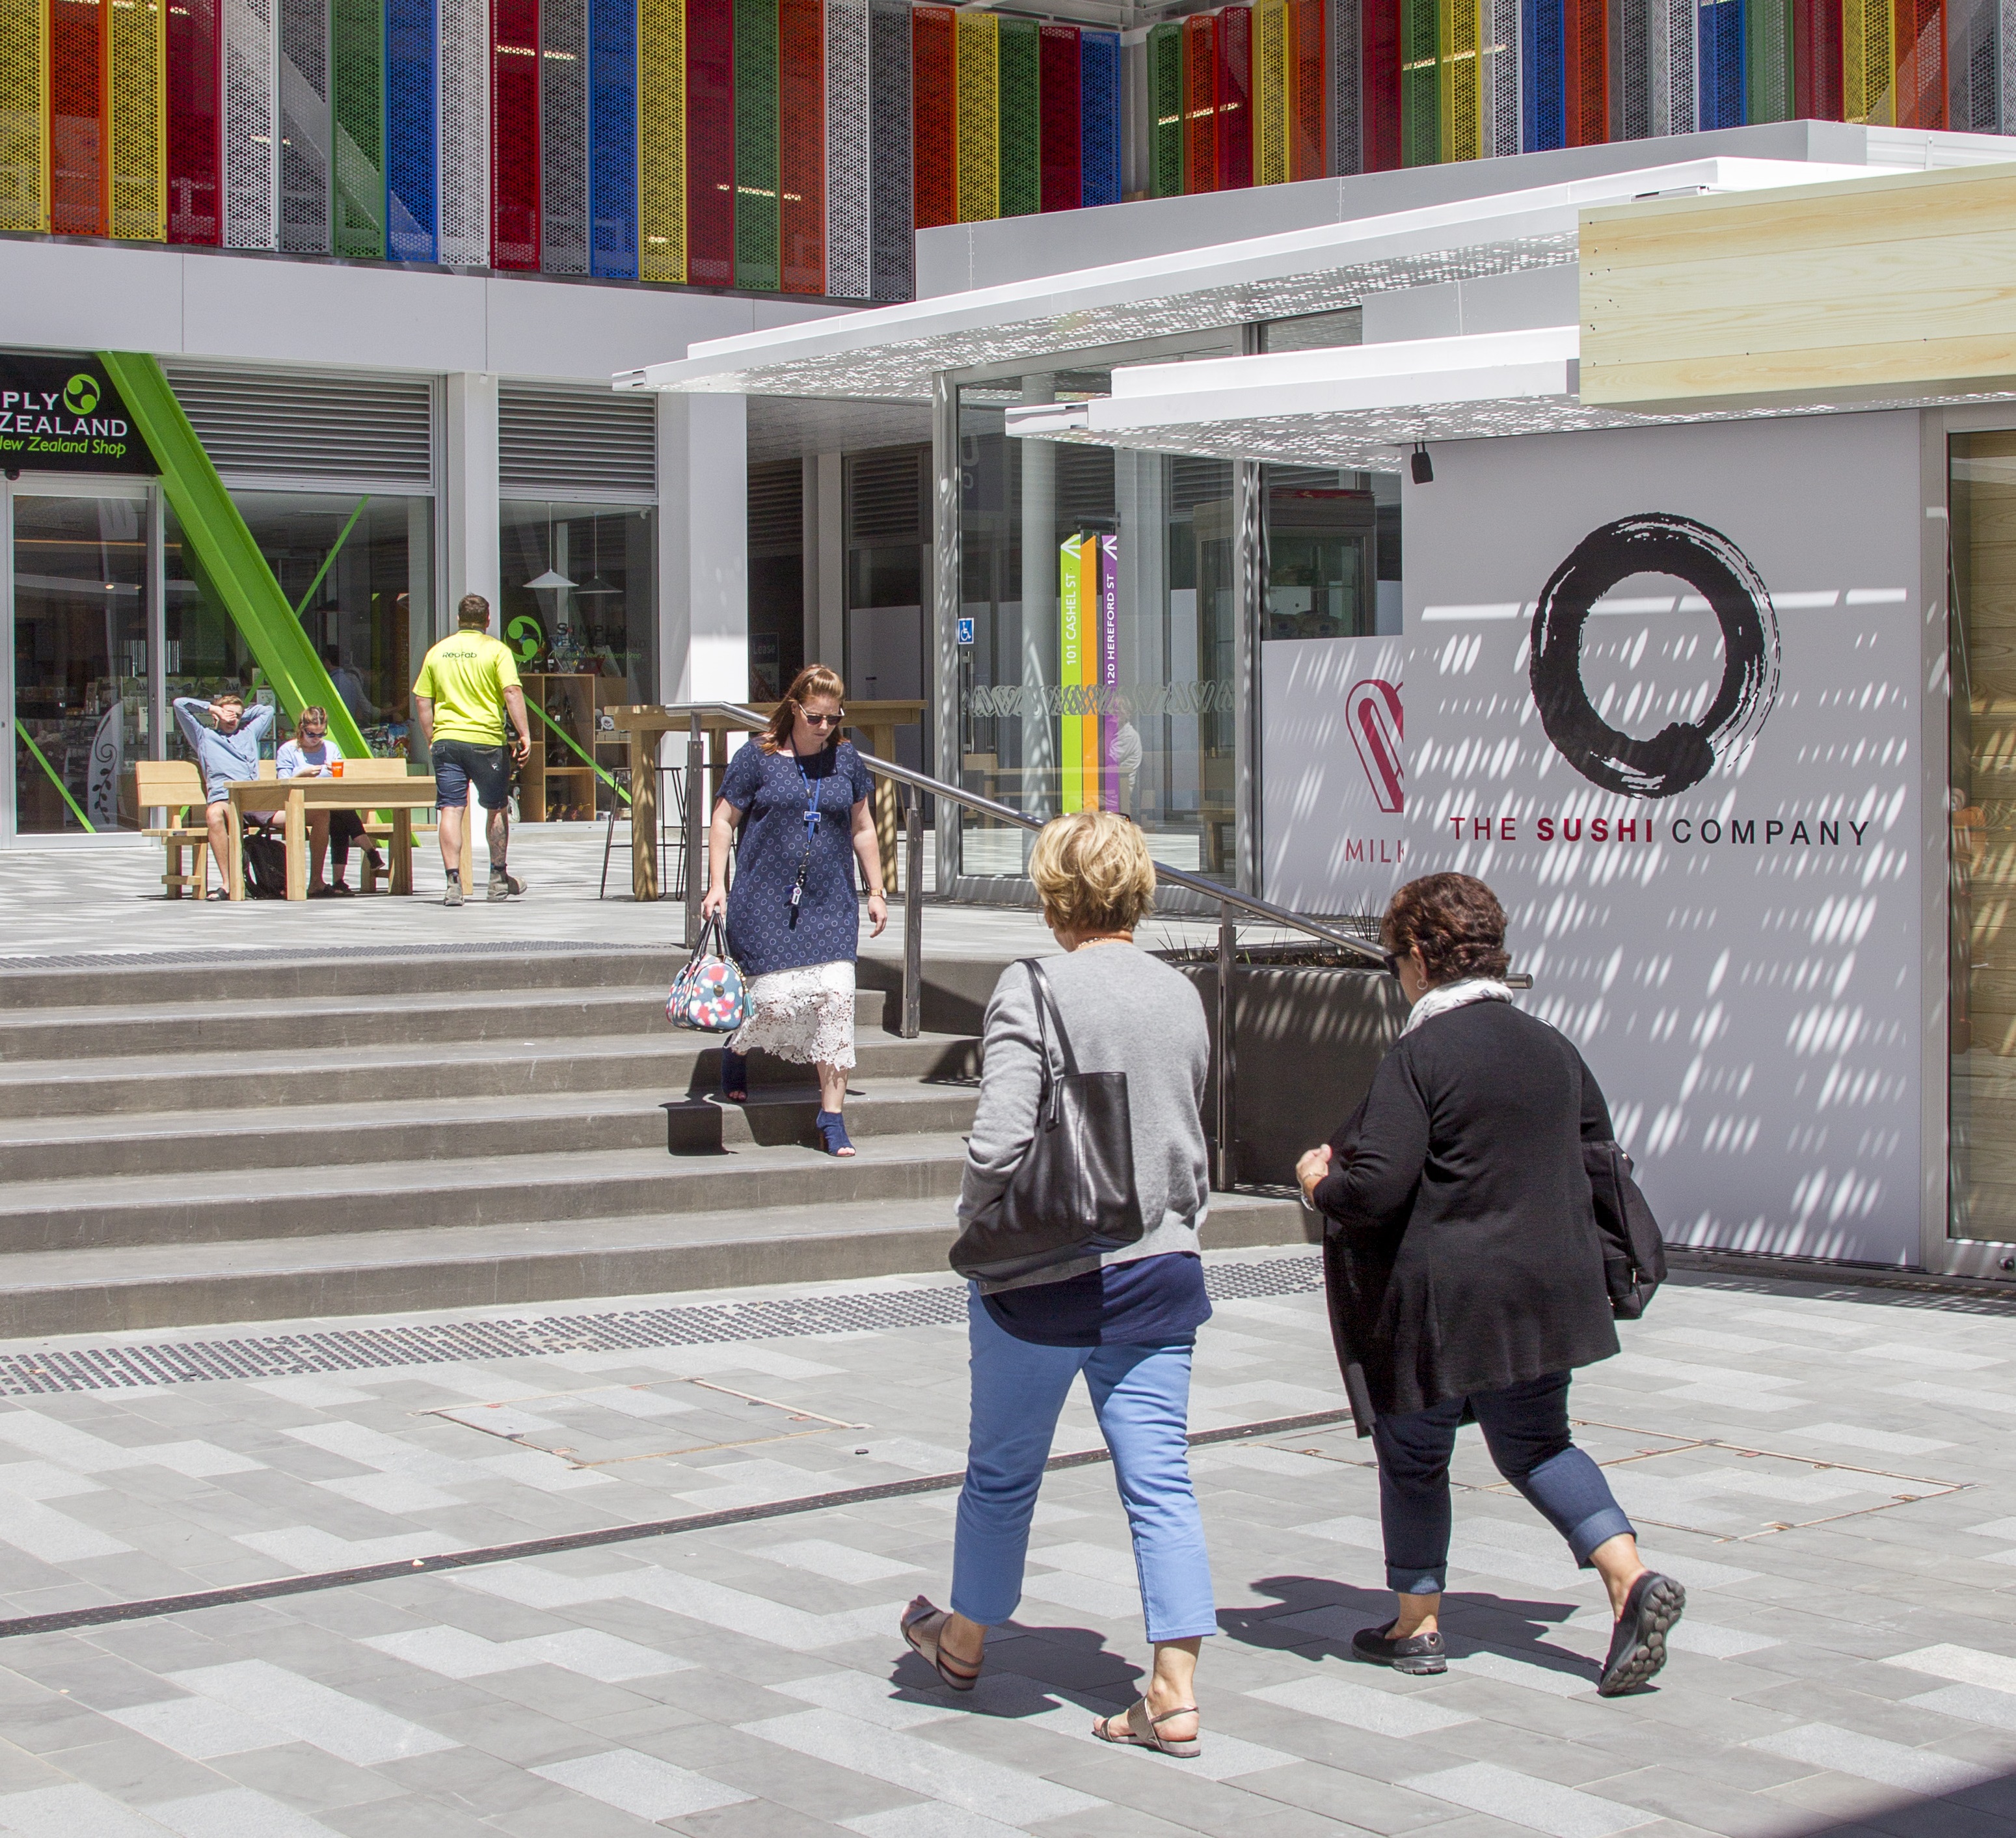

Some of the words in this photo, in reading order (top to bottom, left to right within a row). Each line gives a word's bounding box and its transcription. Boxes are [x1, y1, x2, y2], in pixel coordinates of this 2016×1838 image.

[3, 391, 59, 411] PLY
[0, 411, 128, 437] ZEALAND
[27, 436, 88, 453] Zealand
[92, 439, 126, 458] Shop
[1066, 573, 1076, 588] ST
[1107, 573, 1114, 589] ST
[1066, 591, 1076, 641] CASHEL
[1107, 592, 1115, 660] HEREFORD
[753, 643, 775, 655] Lease
[1066, 646, 1077, 665] 101
[1450, 817, 1516, 841] THE
[1537, 817, 1652, 843] SUSHI
[1672, 818, 1869, 846] COMPANY
